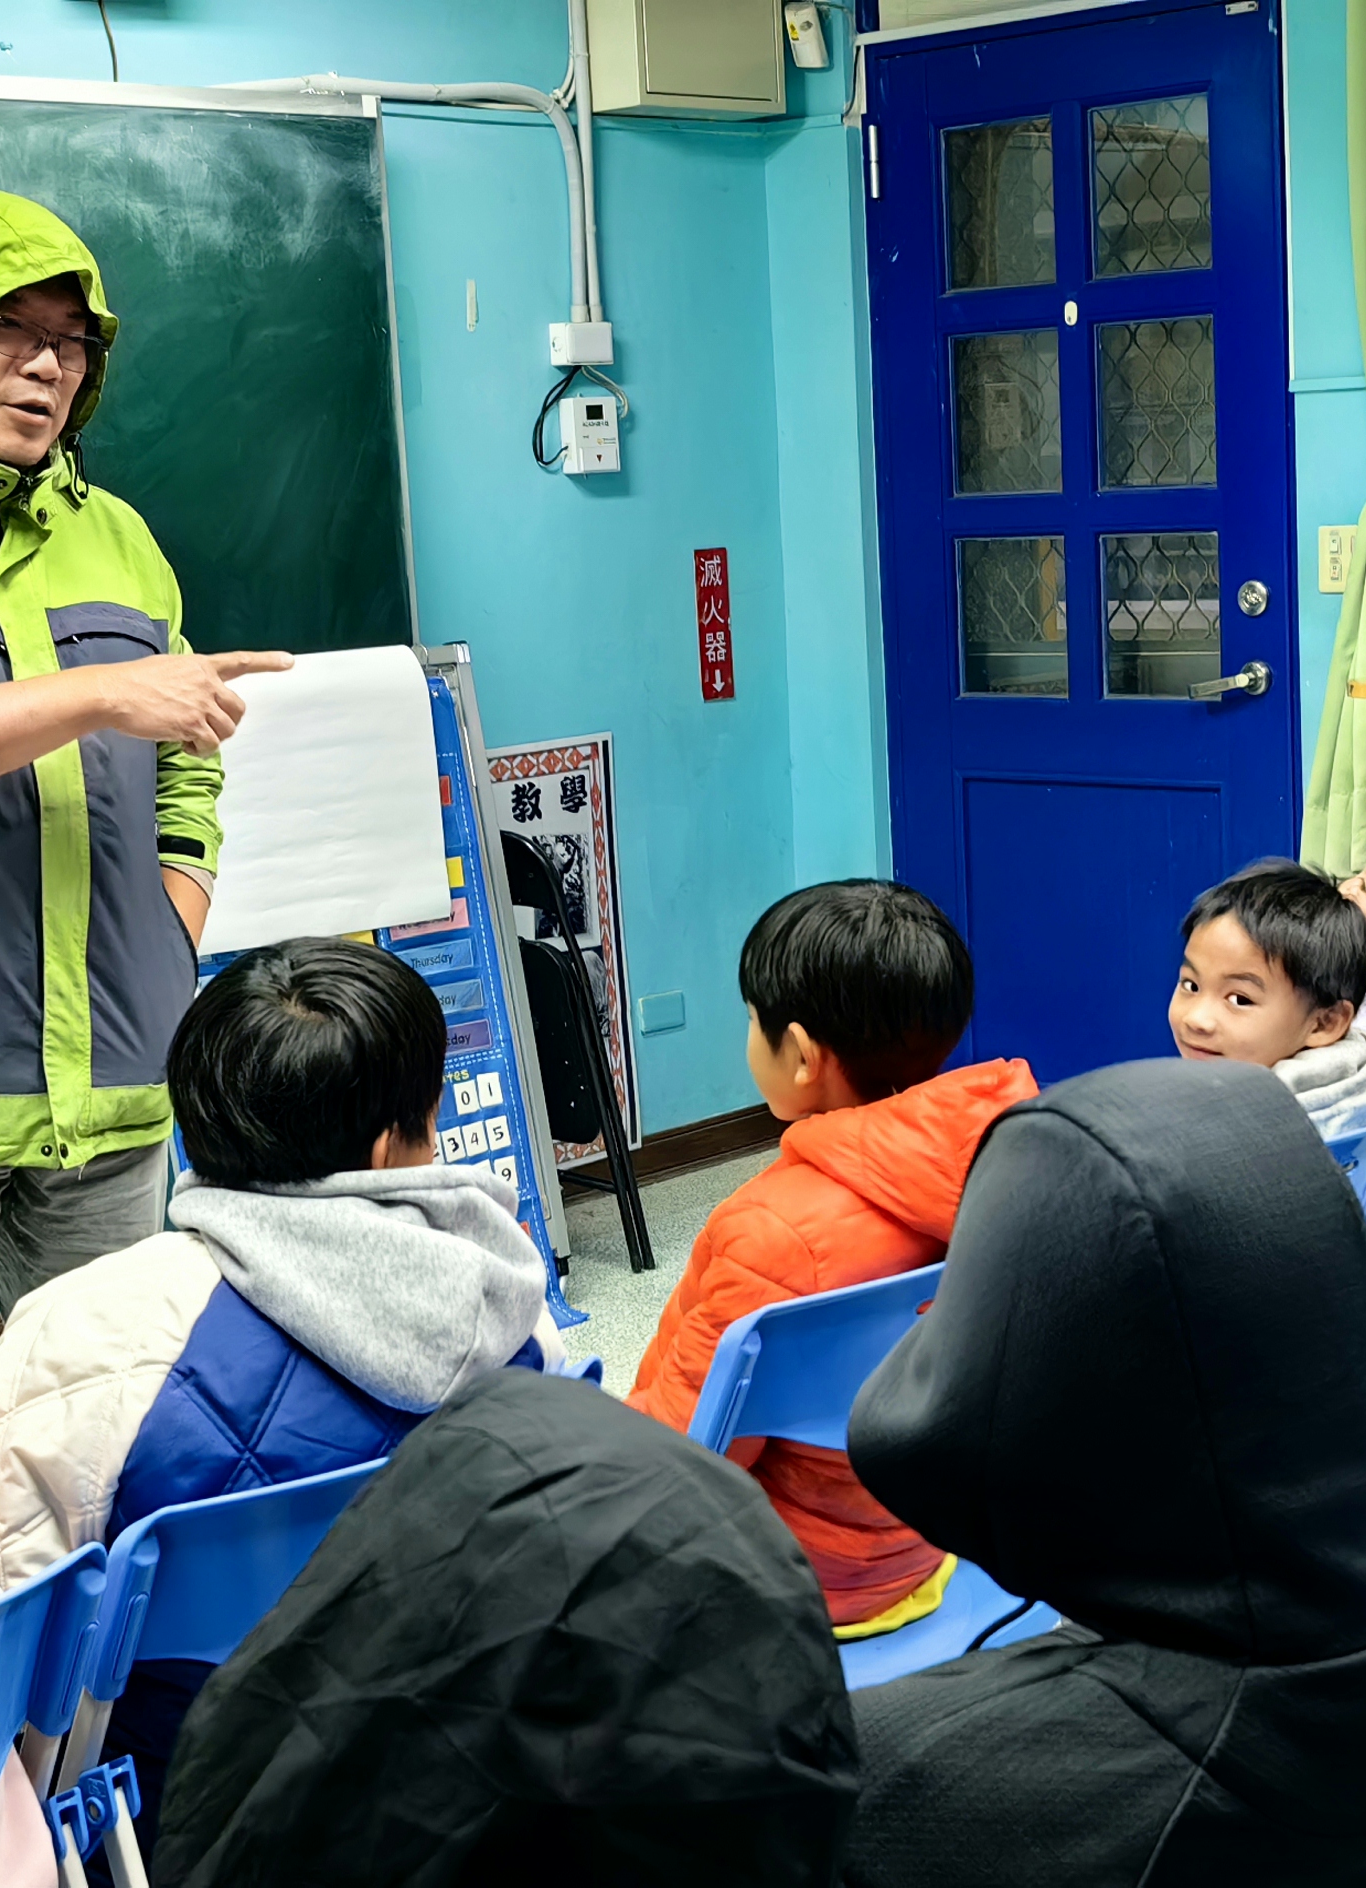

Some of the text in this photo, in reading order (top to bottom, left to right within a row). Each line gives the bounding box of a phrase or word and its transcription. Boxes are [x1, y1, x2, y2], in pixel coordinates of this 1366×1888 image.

[700, 555, 727, 662] 滅火器
[511, 775, 588, 823] 教學
[410, 954, 453, 969] Thursday
[438, 994, 457, 1006] day
[443, 1068, 470, 1083] tes
[460, 1090, 471, 1106] 0
[447, 1137, 460, 1153] 3
[470, 1132, 480, 1146] 4
[492, 1125, 504, 1141] 5
[501, 1167, 512, 1182] 9
